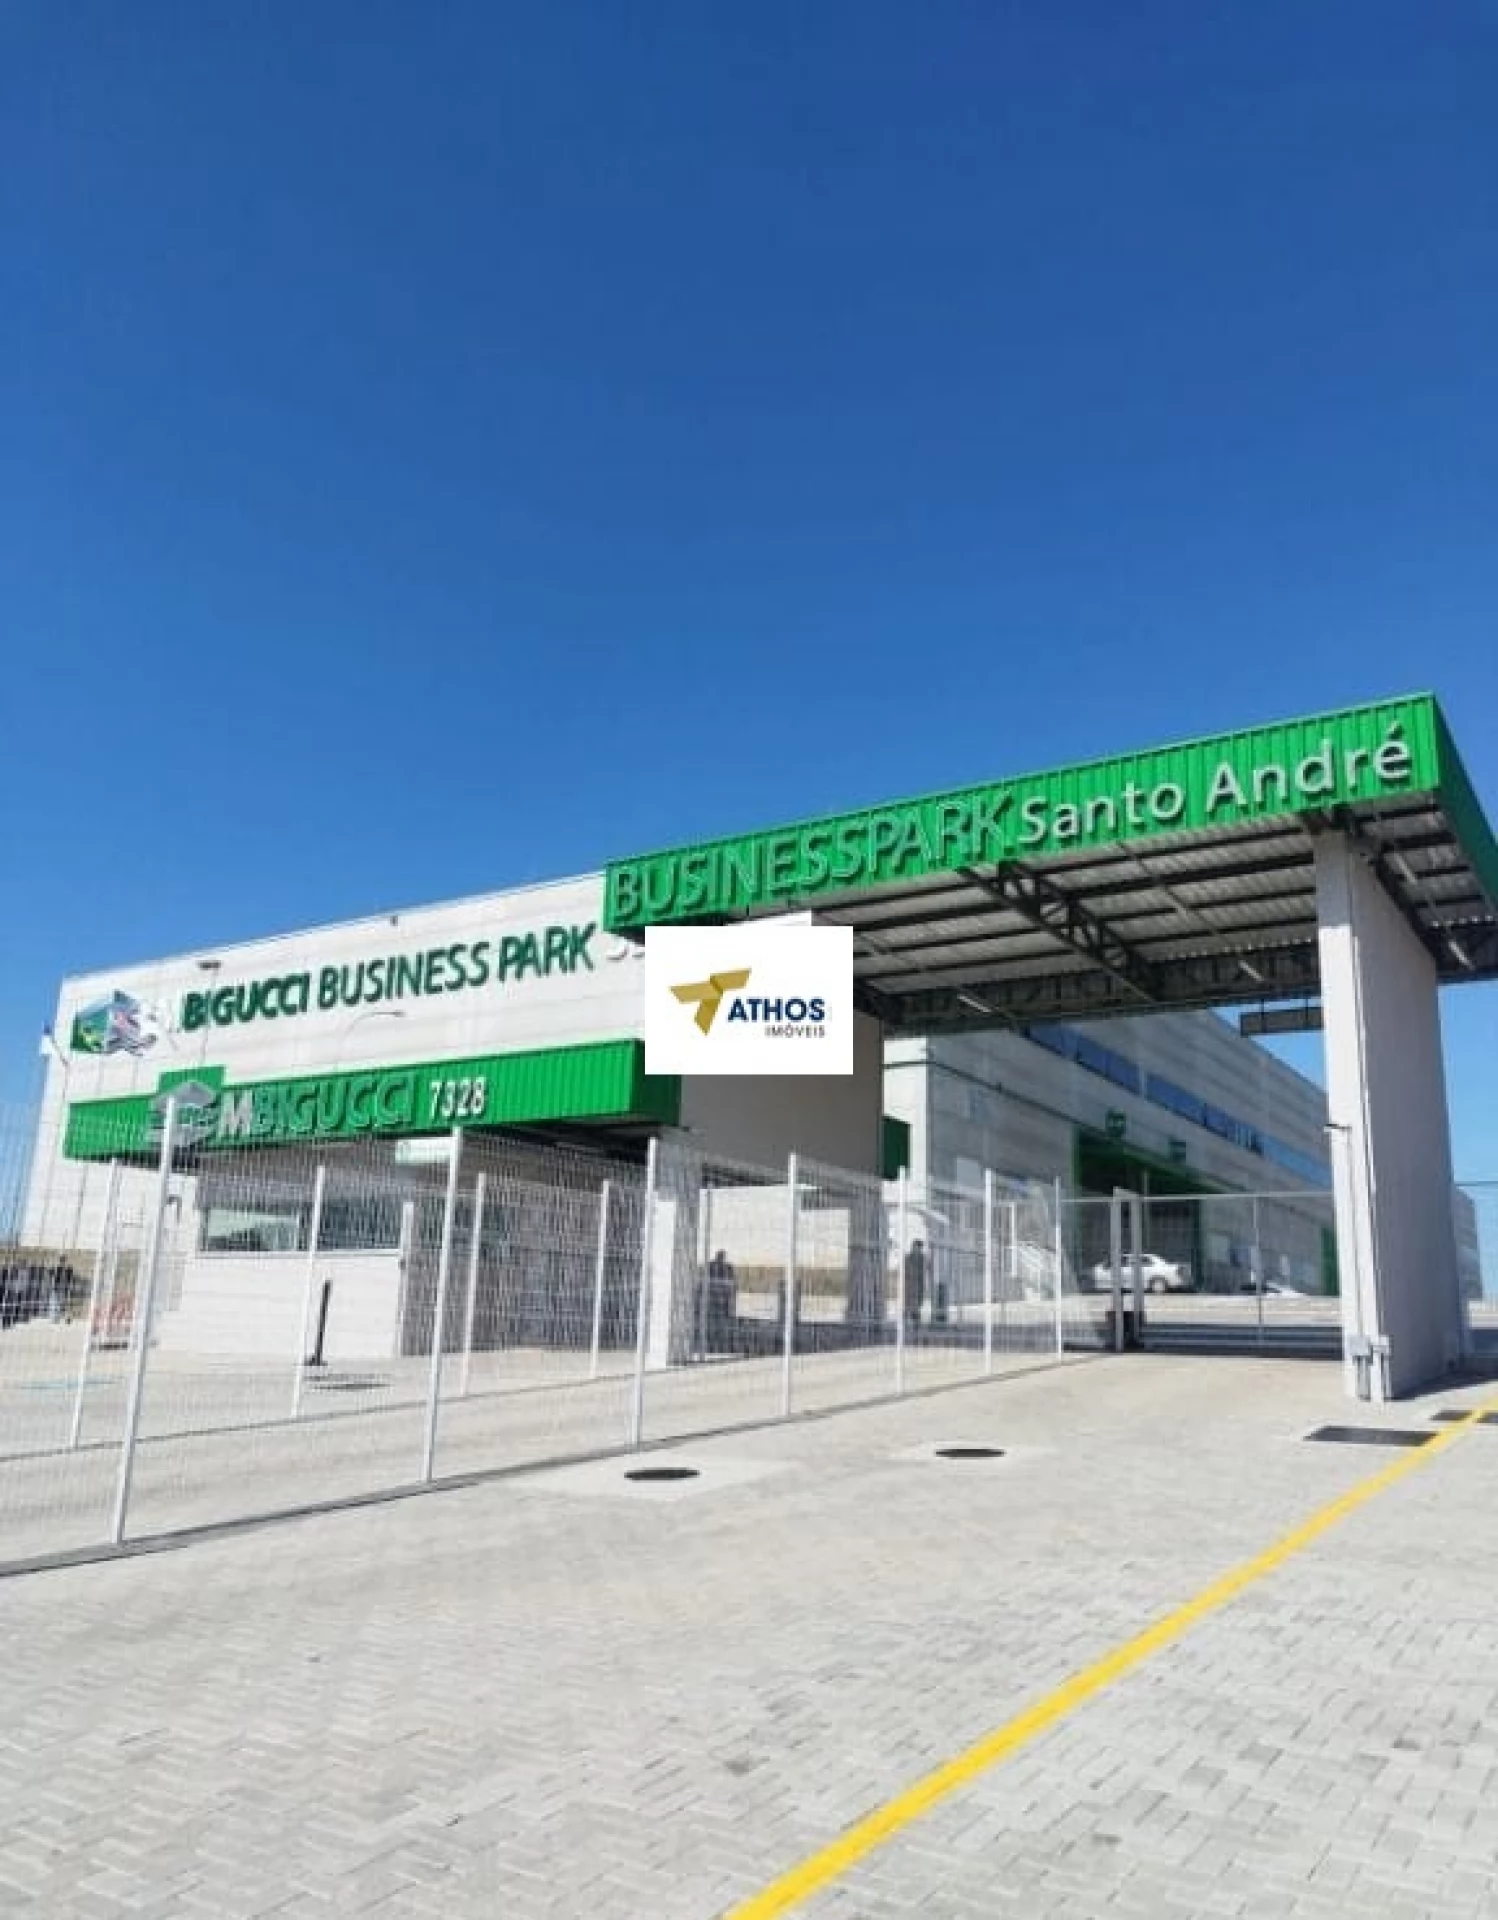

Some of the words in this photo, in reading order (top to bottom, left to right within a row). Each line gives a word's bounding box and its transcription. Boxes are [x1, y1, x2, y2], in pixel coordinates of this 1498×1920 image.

[1018, 783, 1184, 844] Santo
[1206, 721, 1411, 813] André
[317, 940, 490, 1010] BUSINESS
[498, 920, 597, 983] PARK
[215, 1073, 417, 1138] MBIGUCCI
[430, 1076, 486, 1121] 7328
